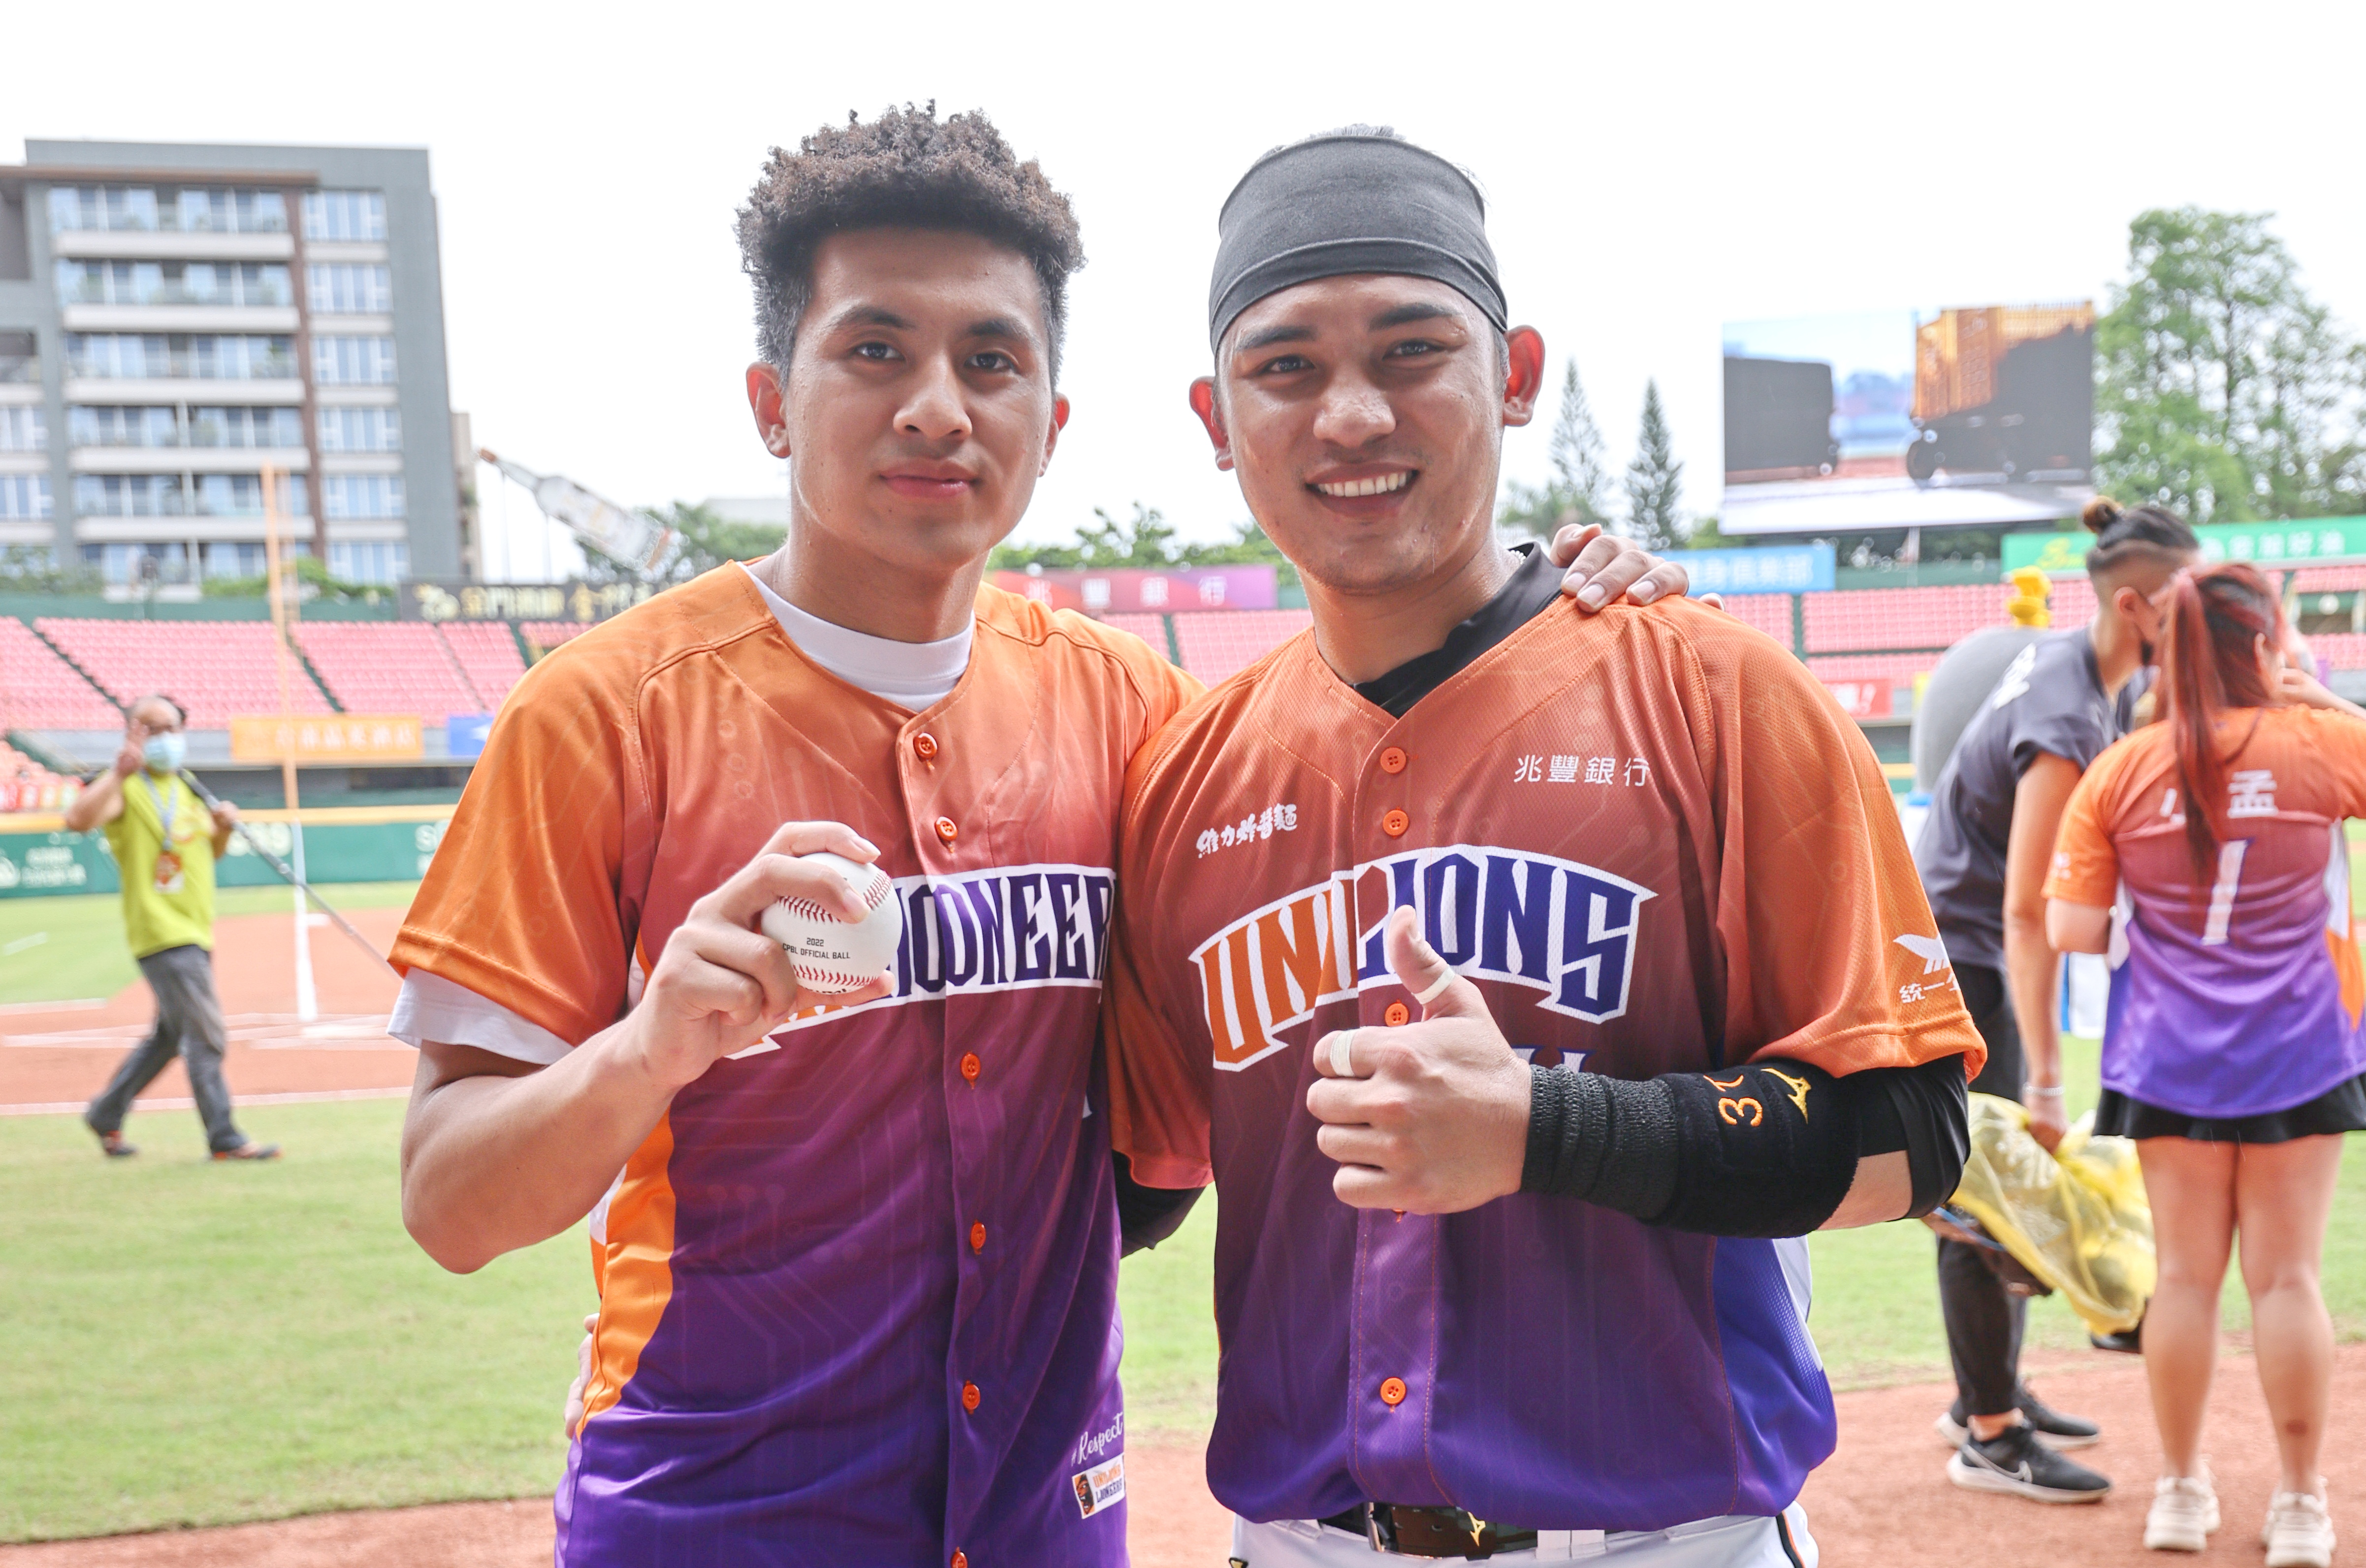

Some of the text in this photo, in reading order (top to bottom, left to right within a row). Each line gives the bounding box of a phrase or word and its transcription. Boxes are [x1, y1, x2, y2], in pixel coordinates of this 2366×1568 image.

[1513, 754, 1650, 787] 兆豐銀行
[782, 943, 798, 954] CPBL
[800, 948, 830, 959] OFFICIAL
[806, 937, 824, 947] 2022
[1071, 1411, 1123, 1467] #Respect
